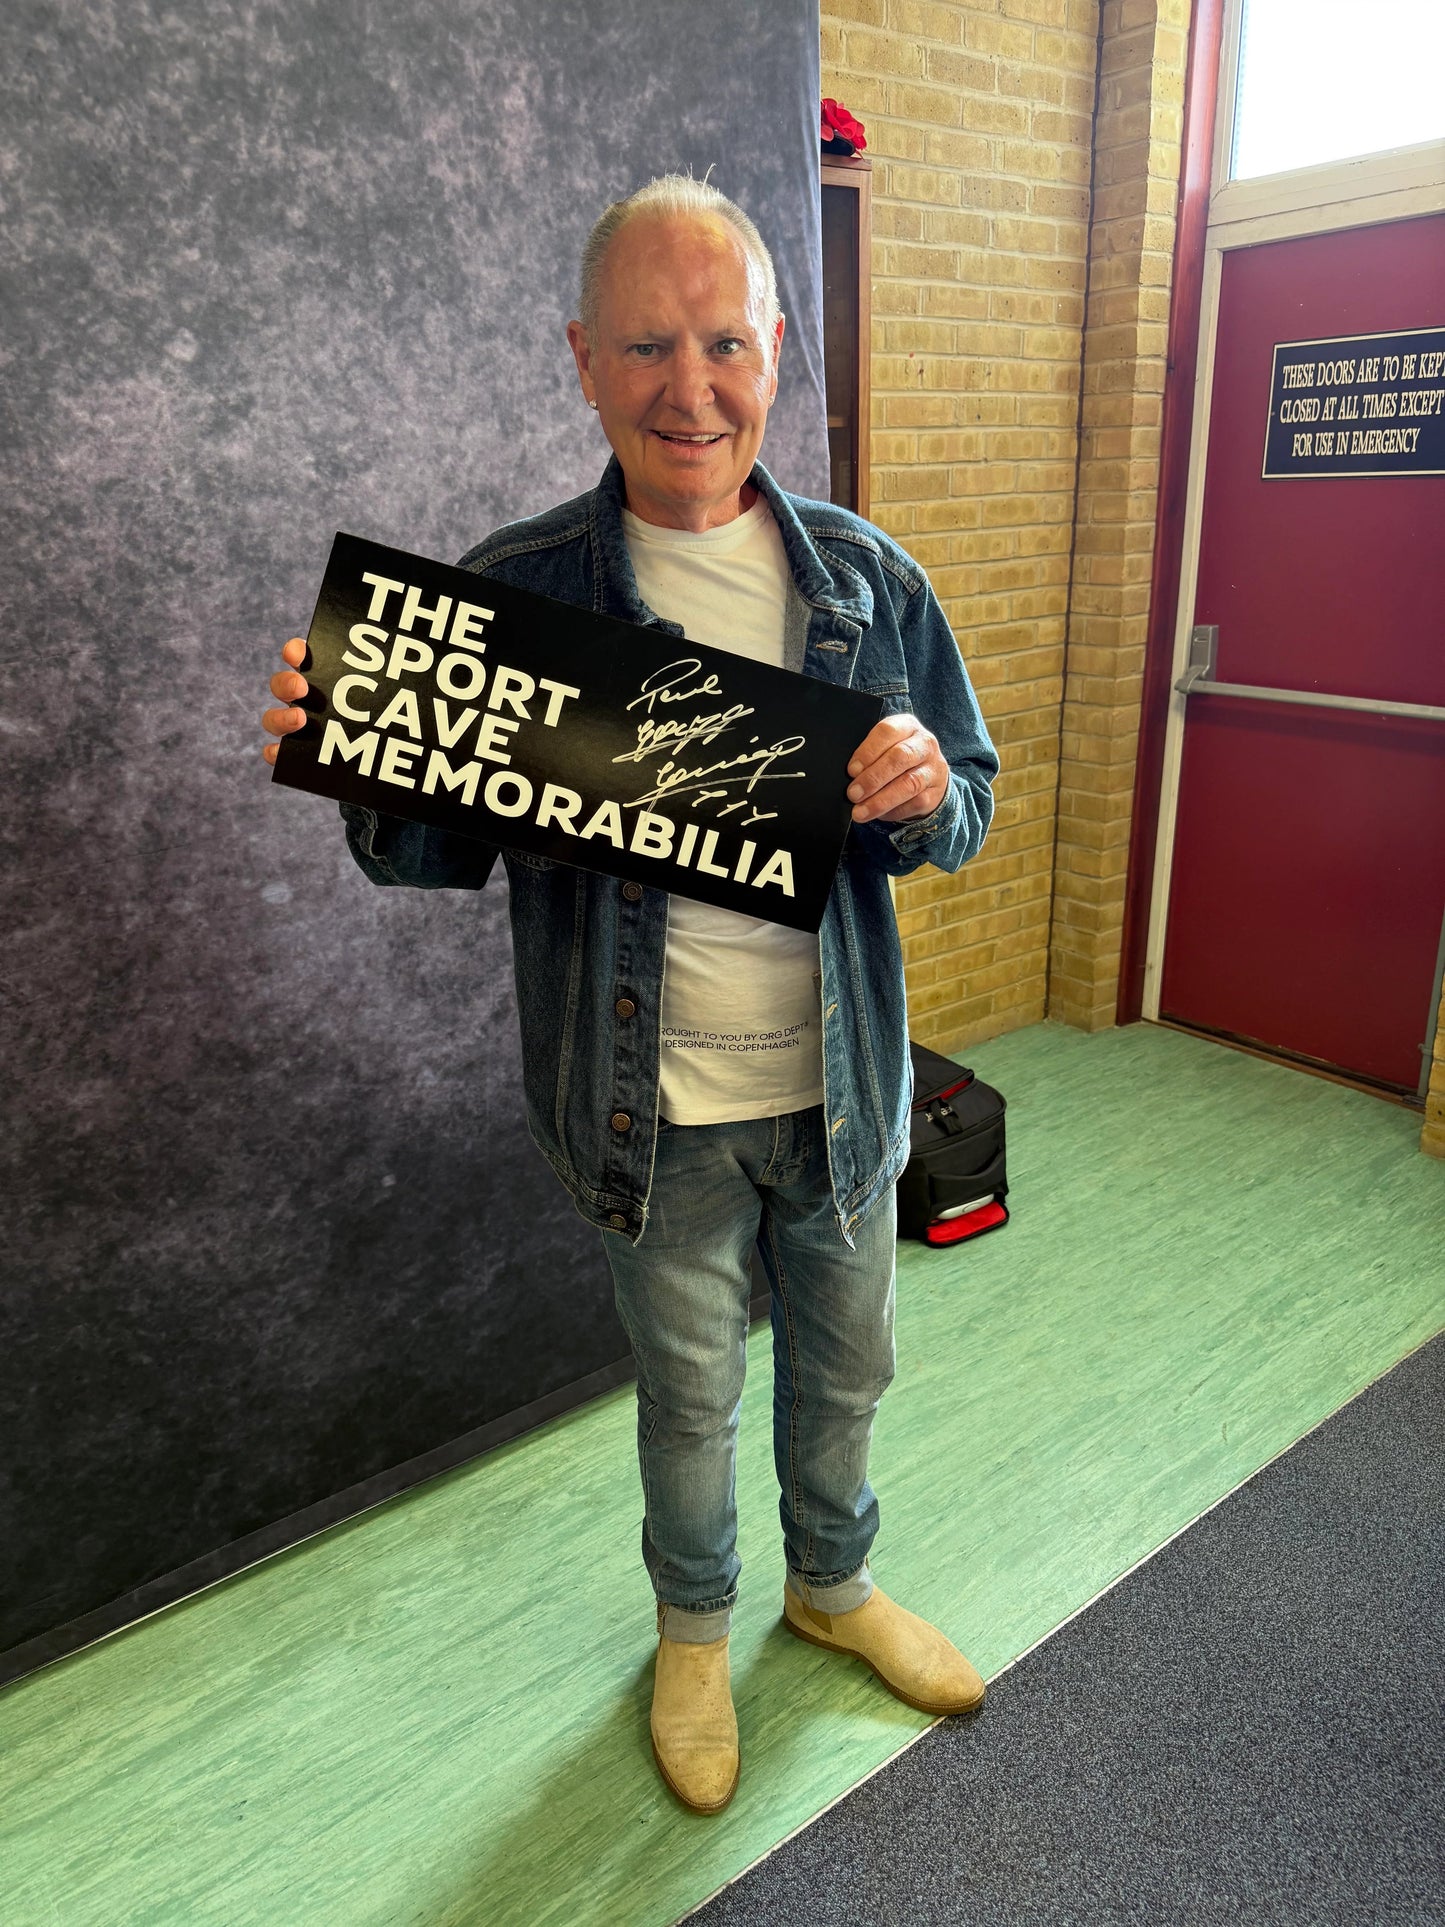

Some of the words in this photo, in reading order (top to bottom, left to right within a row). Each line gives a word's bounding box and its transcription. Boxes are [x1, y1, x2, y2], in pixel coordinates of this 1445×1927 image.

[1282, 363, 1315, 389] THESE
[1316, 359, 1355, 386] DOORS
[1356, 357, 1380, 383] ARE
[1382, 355, 1400, 381] TO
[1401, 354, 1417, 380] BE
[1279, 398, 1320, 423] CLOSED
[1321, 396, 1337, 421] AT
[1337, 395, 1359, 420] ALL
[1362, 392, 1398, 419] TIMES
[1398, 389, 1445, 417] EXCEPT
[1292, 433, 1312, 457] FOR
[1314, 432, 1334, 456] USE
[1335, 431, 1350, 455] IN
[1350, 427, 1421, 455] EMERGENCY
[362, 572, 495, 653] THE
[341, 624, 580, 727] SPORT
[333, 674, 519, 765] CAVE
[318, 720, 794, 898] MEMORABILIA
[661, 1027, 701, 1039] ROUGHT
[703, 1032, 717, 1041] TO
[720, 1034, 742, 1042] YOU
[744, 1034, 757, 1042] BY
[759, 1031, 783, 1042] ORG
[665, 1039, 714, 1049] DESIGNED
[716, 1043, 726, 1051] IN
[728, 1037, 800, 1052] COPENHAGEN
